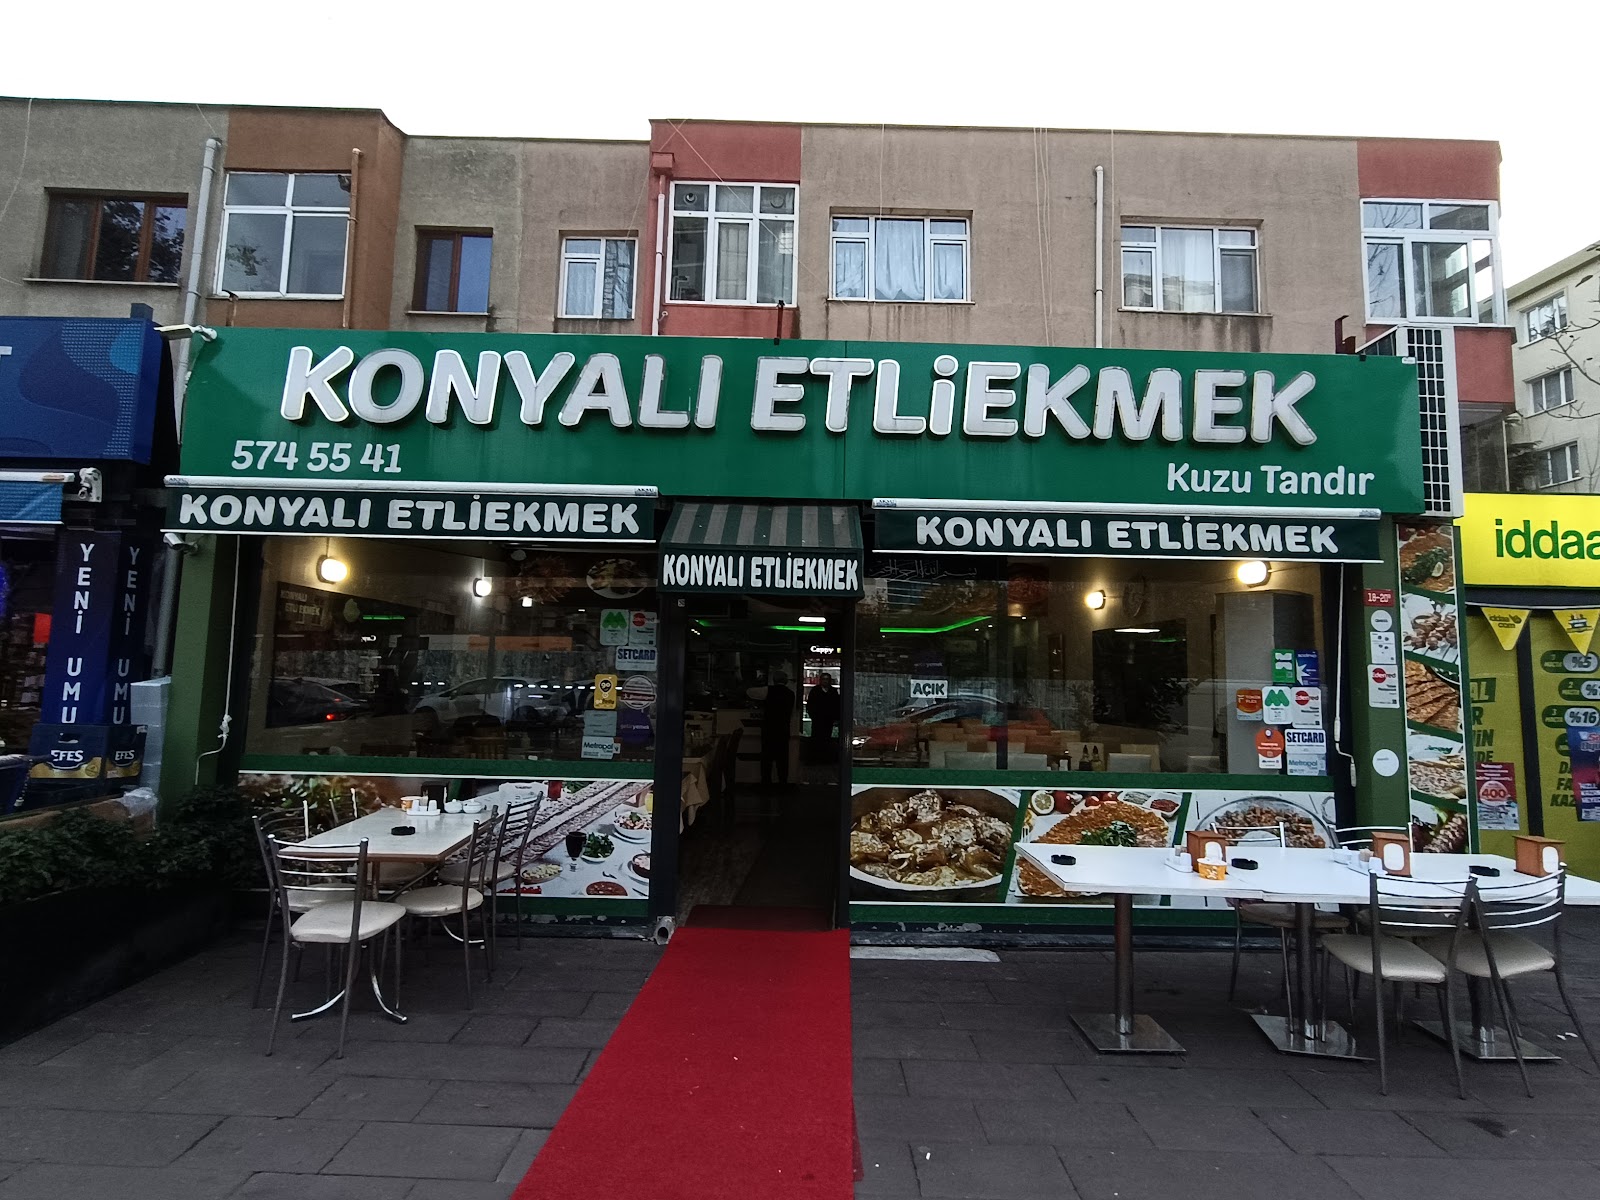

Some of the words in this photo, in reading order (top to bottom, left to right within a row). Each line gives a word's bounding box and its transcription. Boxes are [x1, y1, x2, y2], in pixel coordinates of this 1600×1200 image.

[279, 345, 725, 430] KONYALI
[231, 439, 299, 470] 574
[306, 441, 353, 473] 55
[359, 443, 402, 473] 41
[1167, 462, 1252, 494] Kuzu
[1261, 465, 1375, 496] Tandır
[179, 493, 373, 529] KONYALI
[916, 515, 1092, 548] KONYALI
[1495, 518, 1600, 560] iddaa
[662, 553, 745, 587] KONYALI
[617, 648, 656, 661] SETCARD
[61, 657, 83, 724] UMU
[912, 682, 945, 697] AÇIK
[1569, 711, 1597, 724] %16
[1286, 731, 1325, 744] SETCARD
[51, 750, 84, 762] EFES
[114, 750, 135, 761] EFES
[1481, 788, 1507, 798] 400
